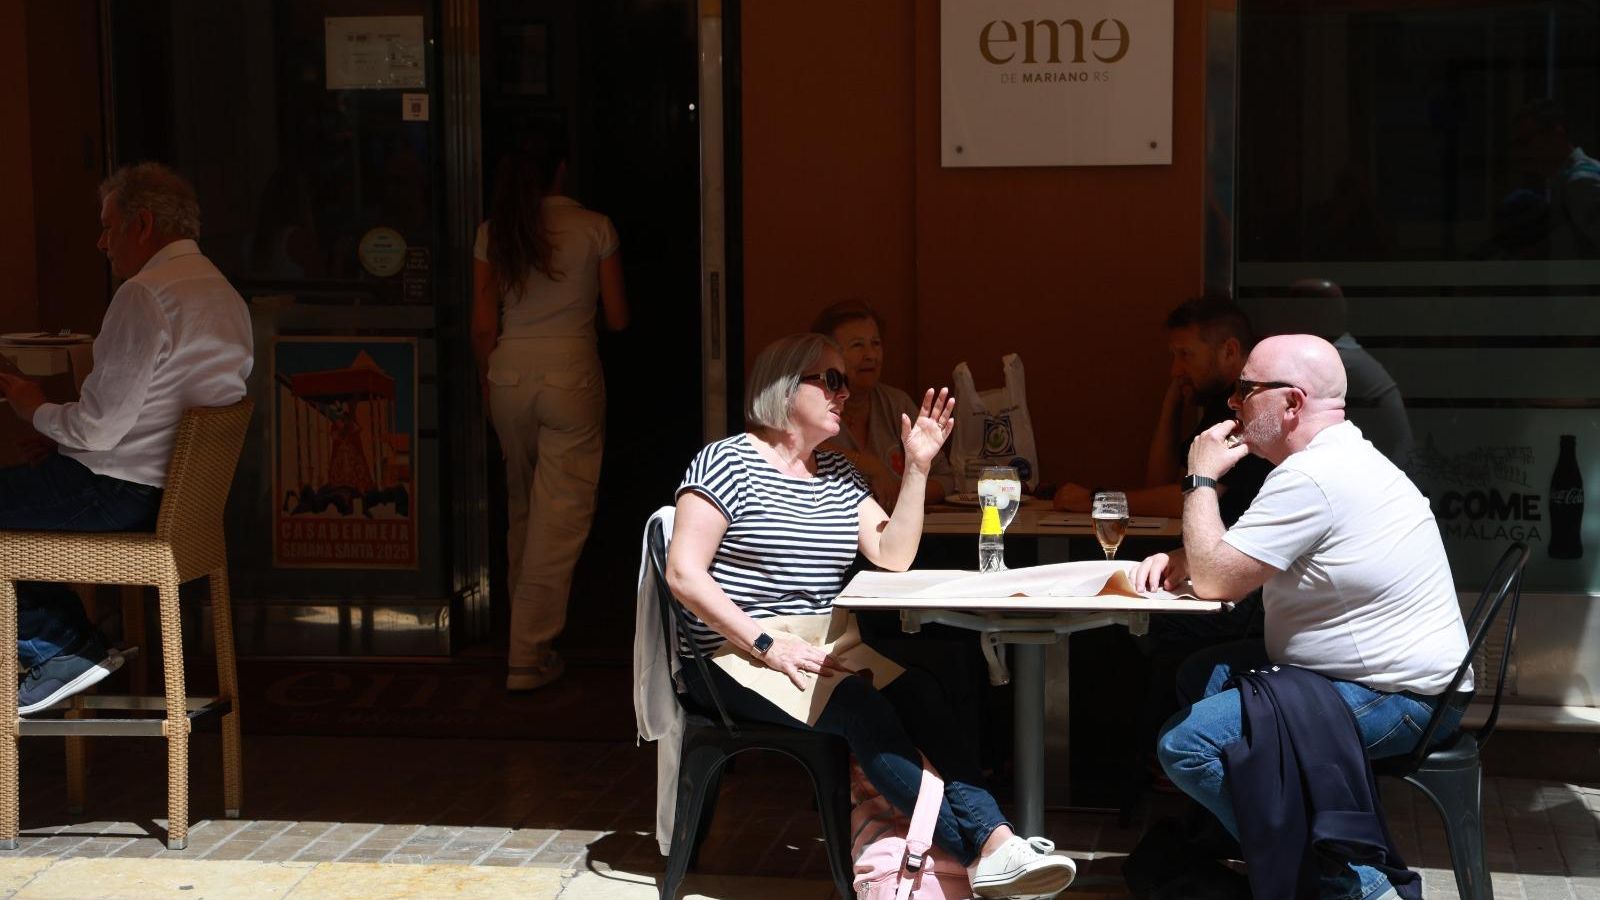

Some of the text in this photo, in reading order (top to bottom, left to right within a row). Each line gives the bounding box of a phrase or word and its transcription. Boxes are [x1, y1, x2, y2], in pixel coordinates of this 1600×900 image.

[1001, 71, 1110, 84] DE MARIANO RS
[1438, 488, 1541, 521] COME
[280, 521, 409, 541] CASABERMEJA
[280, 541, 410, 561] SEMANA SANTA 2025
